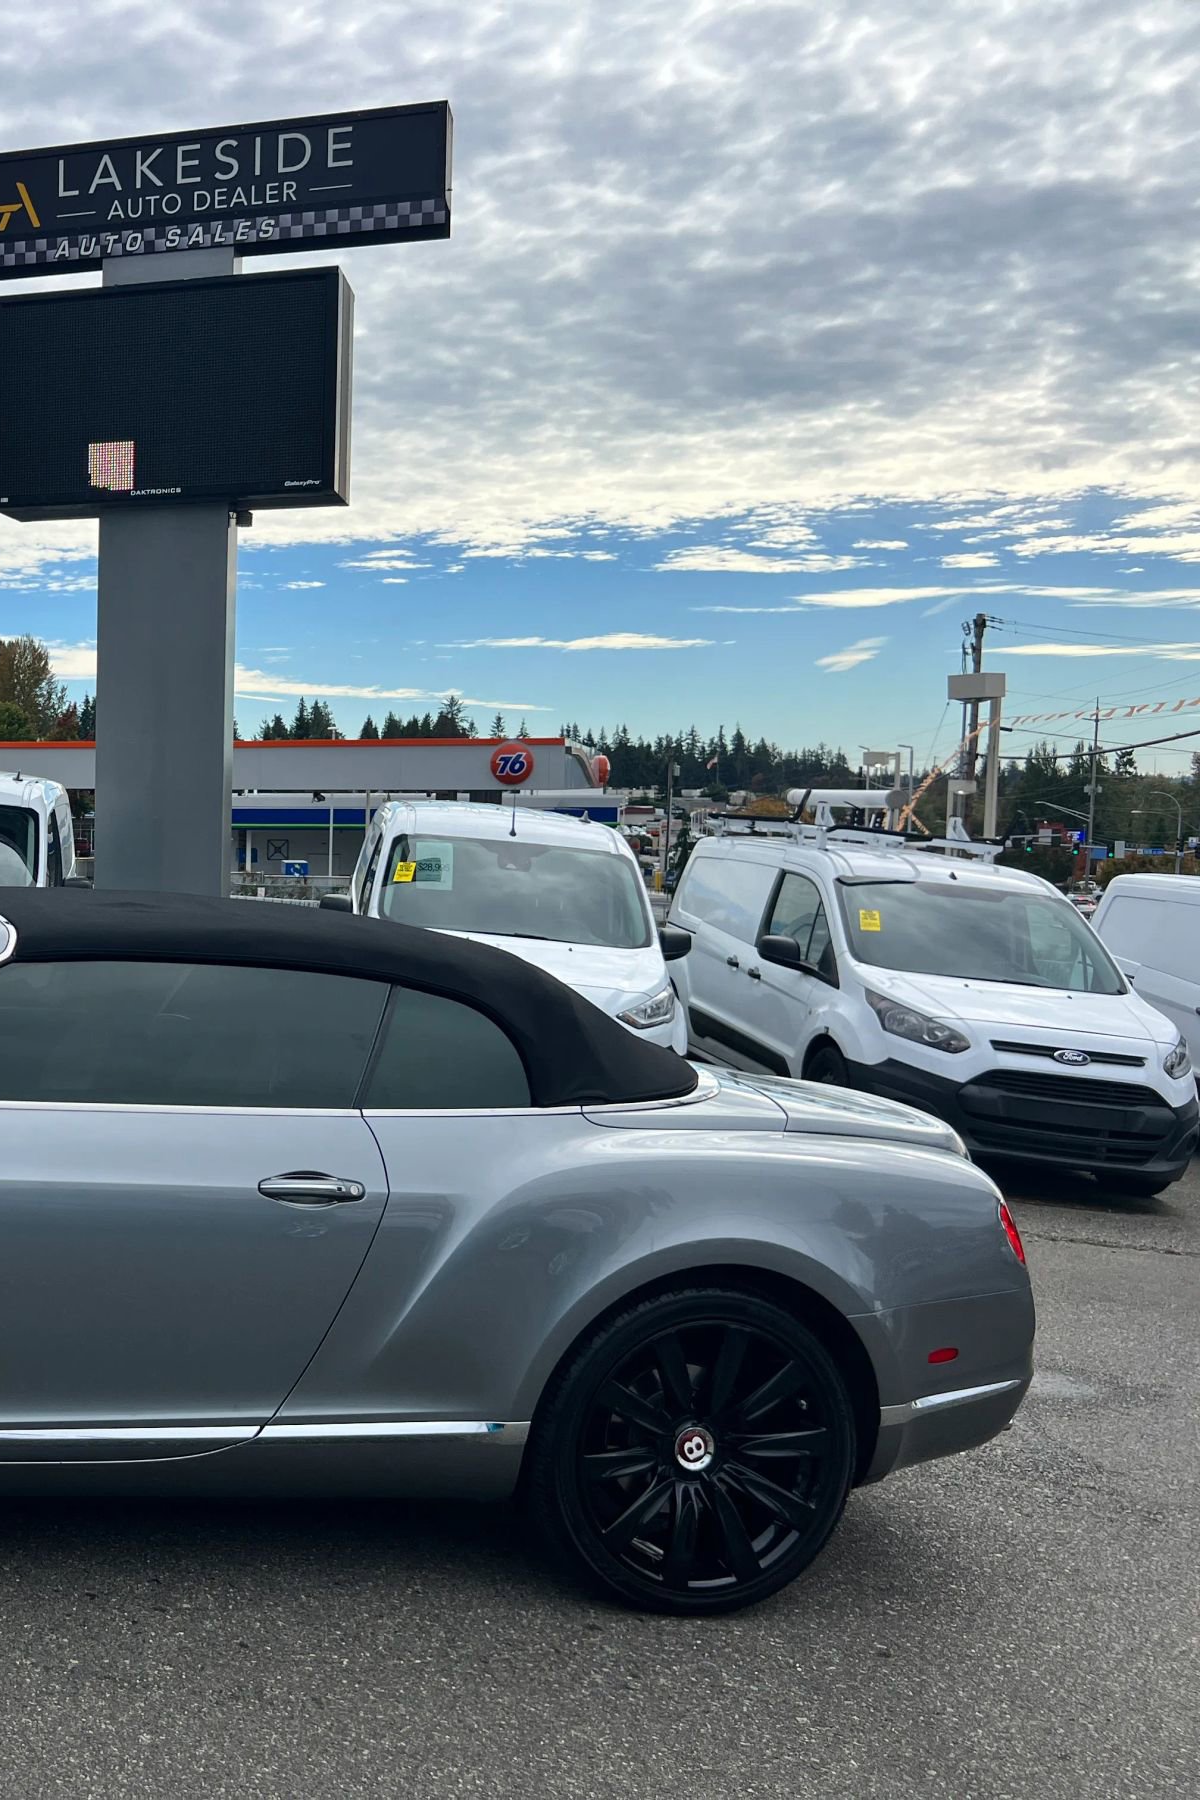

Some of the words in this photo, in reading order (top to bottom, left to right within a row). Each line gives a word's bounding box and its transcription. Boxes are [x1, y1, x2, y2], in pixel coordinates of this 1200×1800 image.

[58, 126, 353, 198] LAKESIDE
[107, 193, 182, 220] AUTO
[193, 181, 297, 211] DEALER
[55, 233, 142, 259] AUTO
[166, 219, 275, 248] SALES
[130, 487, 182, 496] DAKTRONICS
[495, 751, 527, 776] 76
[1062, 1051, 1084, 1062] Ford
